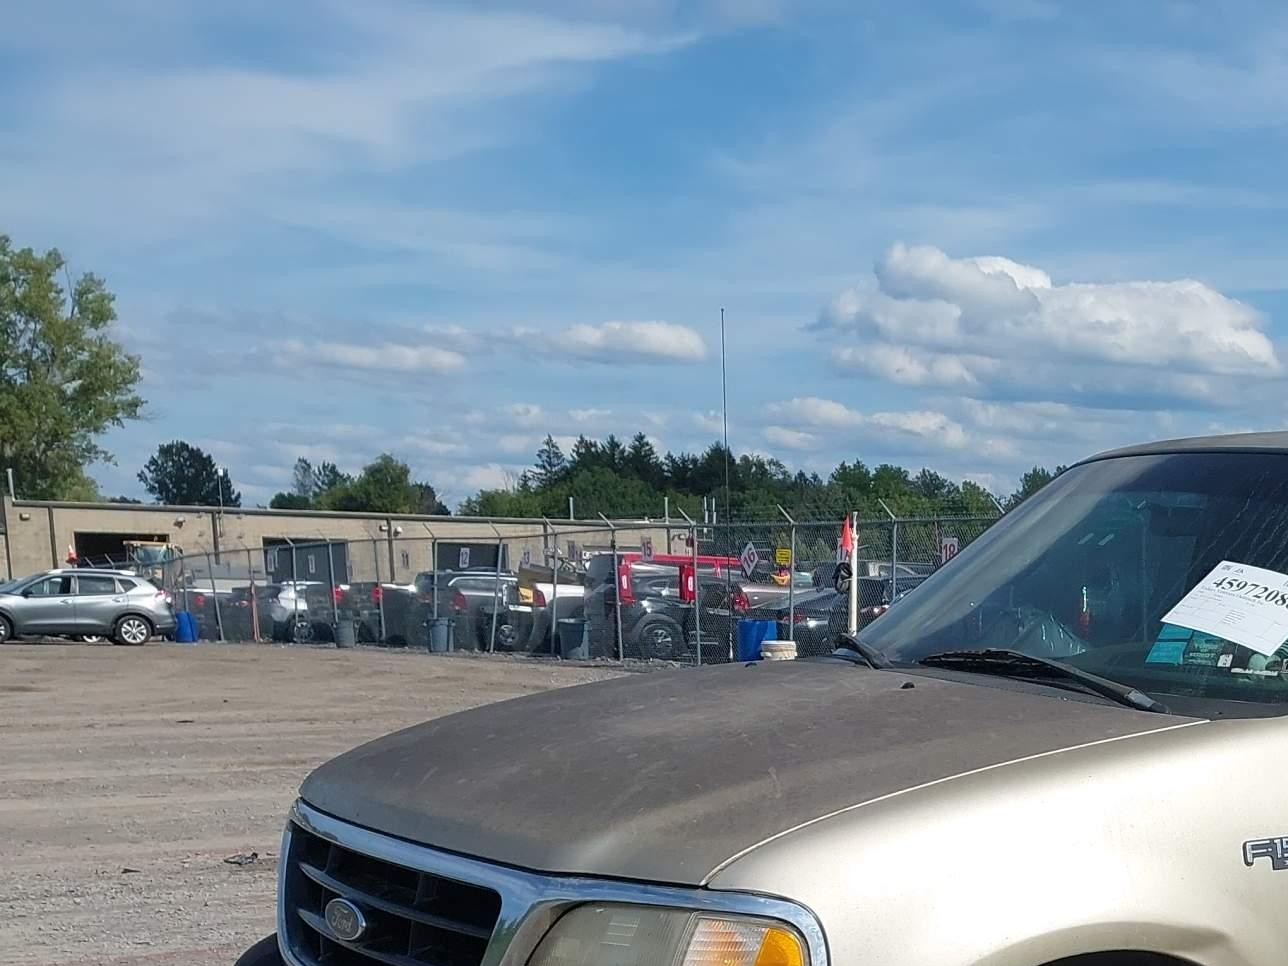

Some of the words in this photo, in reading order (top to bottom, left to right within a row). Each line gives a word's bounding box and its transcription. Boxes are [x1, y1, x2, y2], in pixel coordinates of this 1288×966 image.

[460, 550, 469, 565] 12
[642, 541, 653, 558] 15
[743, 547, 757, 568] 16
[943, 543, 956, 560] 18
[332, 905, 353, 932] Ford
